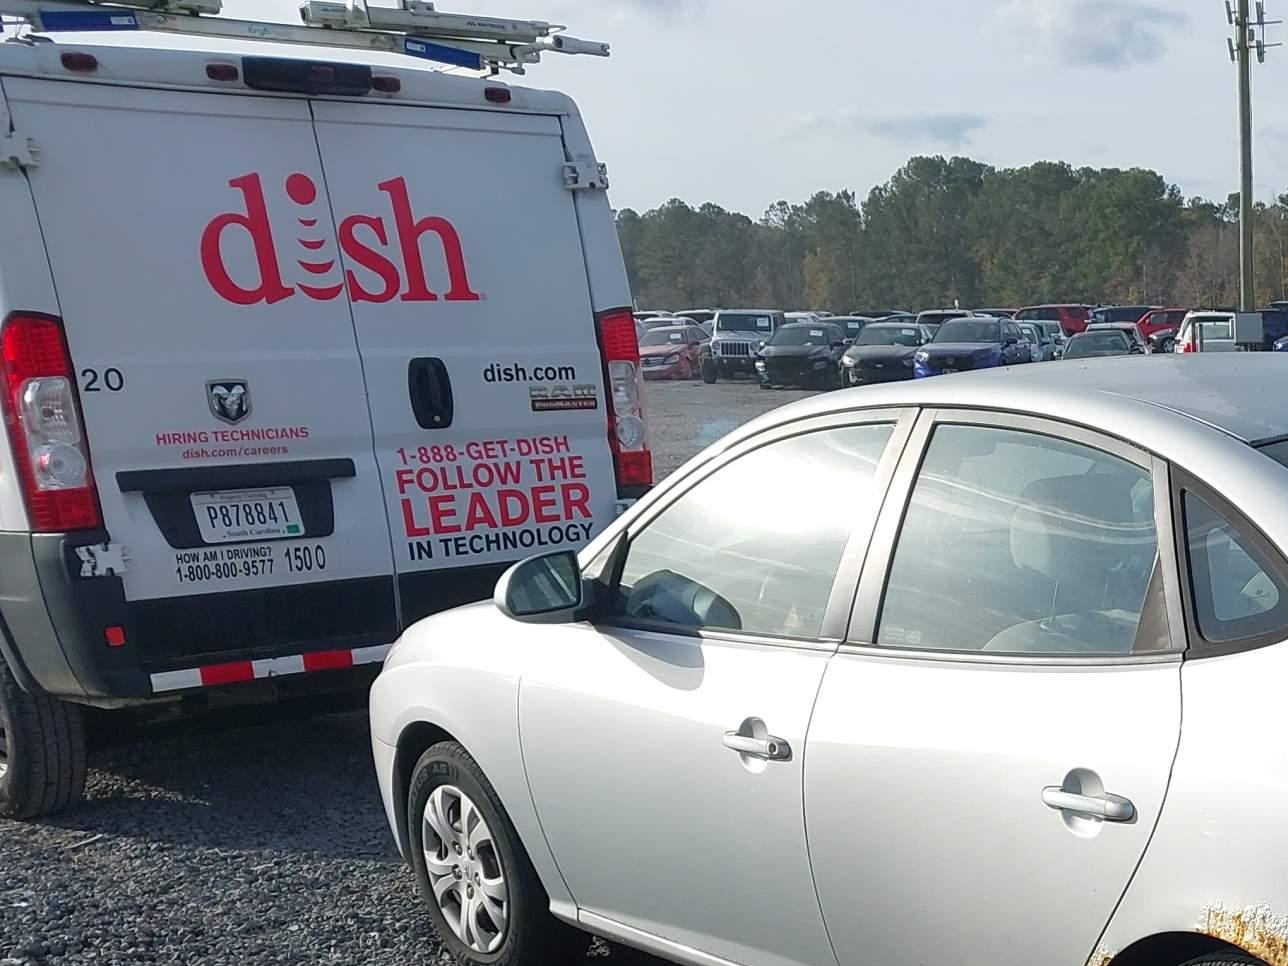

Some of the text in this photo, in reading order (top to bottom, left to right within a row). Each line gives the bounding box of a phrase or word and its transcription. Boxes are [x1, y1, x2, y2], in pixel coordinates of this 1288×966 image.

[200, 172, 479, 305] dish
[81, 367, 124, 391] 20
[483, 363, 575, 382] dish.com
[529, 384, 596, 398] RAM
[156, 427, 309, 445] HIRING TECHNICIANS
[182, 445, 288, 459] dish.com/careers
[396, 435, 570, 465] 1-888-GET-DISH
[396, 456, 586, 494] FOLLOW THE
[206, 501, 289, 528] P878841
[401, 483, 592, 537] LEADER
[227, 529, 248, 537] South
[408, 522, 593, 560] IN TECHNOLOGY
[176, 553, 200, 564] HOW
[203, 551, 218, 561] AM
[227, 546, 272, 560] DRIVING?
[176, 559, 274, 582] 1-800-800-9577
